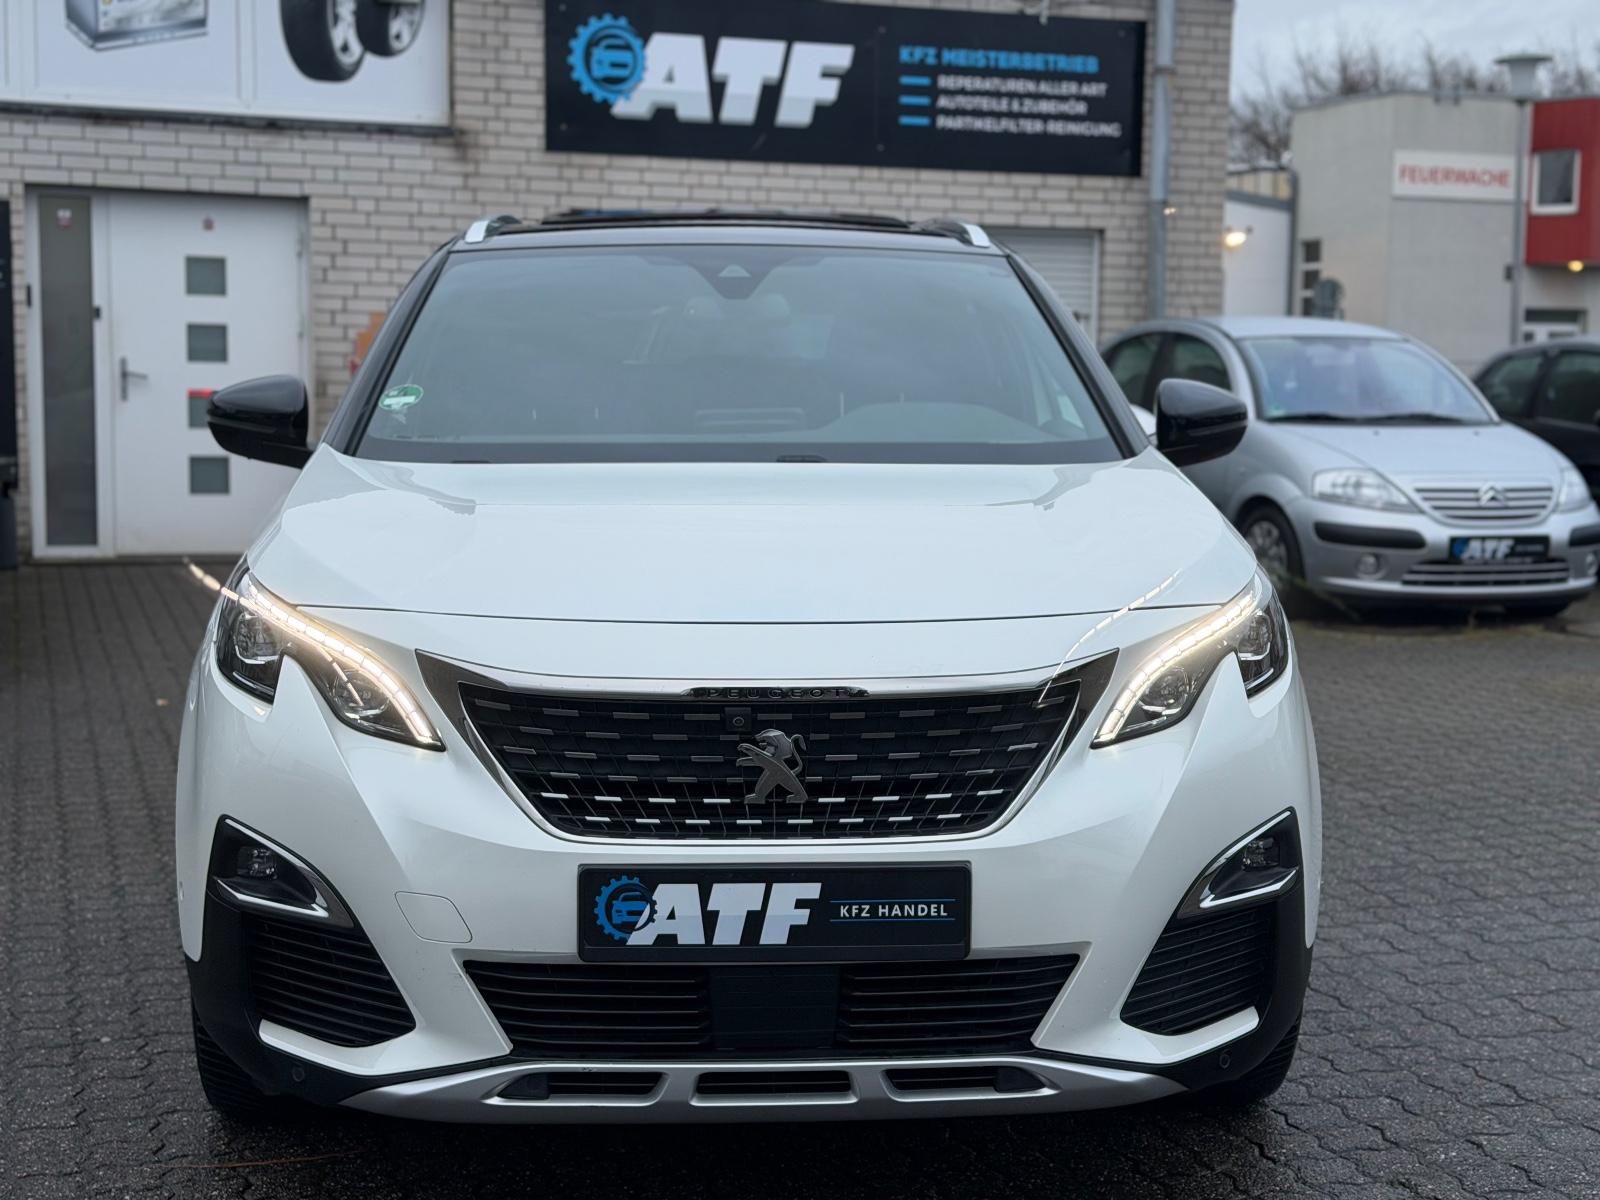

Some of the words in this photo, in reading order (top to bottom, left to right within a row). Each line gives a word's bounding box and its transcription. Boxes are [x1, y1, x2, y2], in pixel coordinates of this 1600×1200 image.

[899, 46, 937, 65] KFZ
[941, 48, 1099, 74] MEISTERBETRIEB
[610, 31, 855, 128] ATF
[1038, 80, 1080, 97] ALLER
[1080, 81, 1108, 98] ART
[936, 93, 1009, 112] AUTOTEILE
[1398, 164, 1511, 188] FEUERWACHE
[1461, 538, 1515, 560] ATF
[706, 688, 845, 699] PEUGEOT
[626, 882, 822, 945] ATF
[840, 905, 871, 917] KFZ
[878, 904, 948, 916] HANDEL
